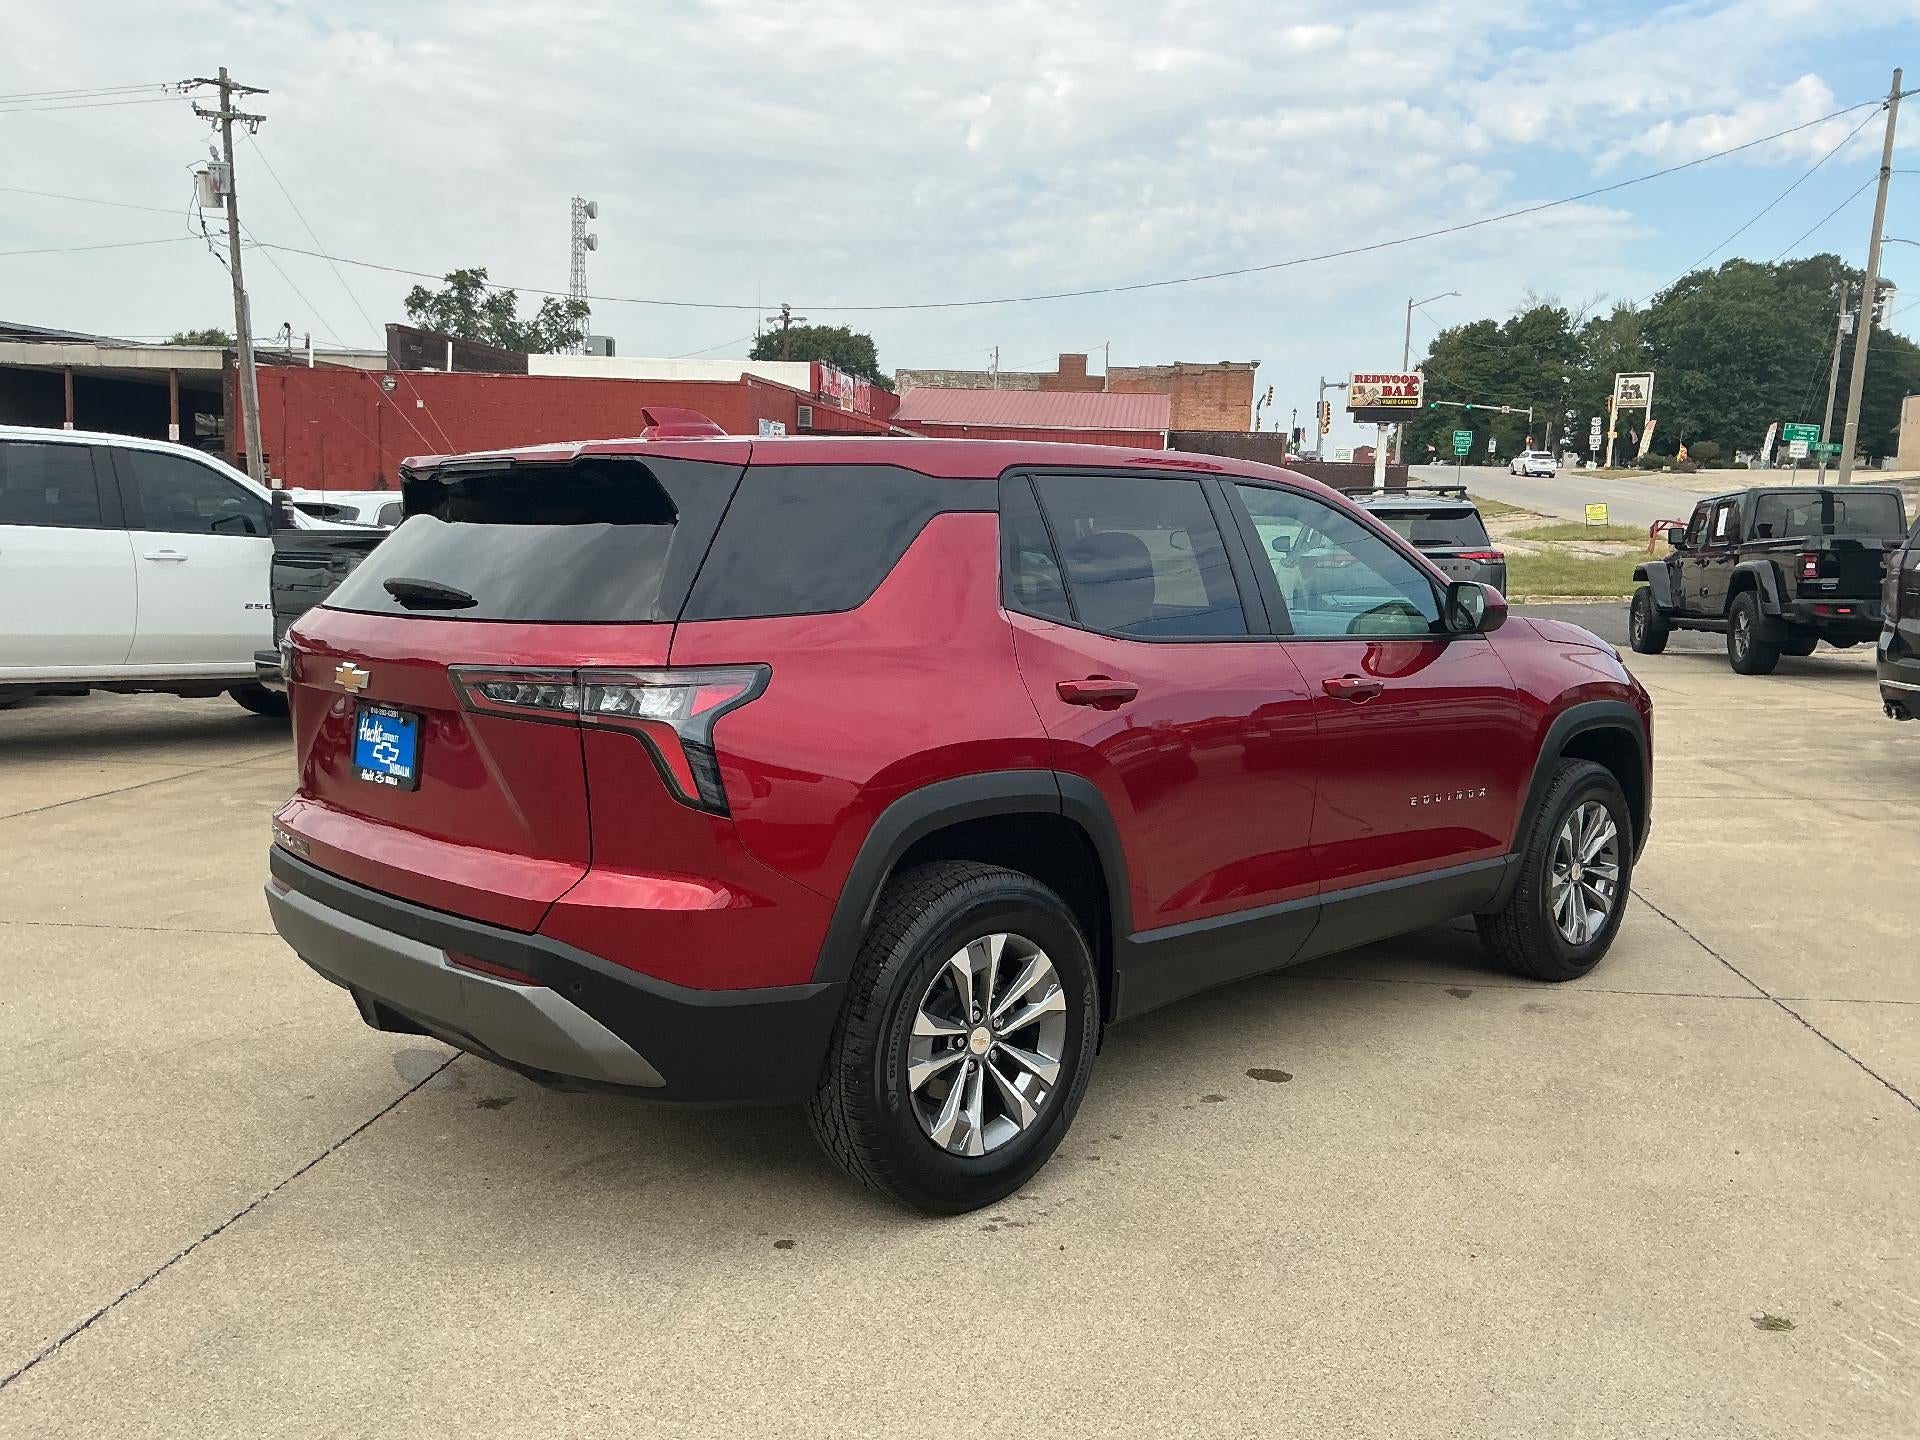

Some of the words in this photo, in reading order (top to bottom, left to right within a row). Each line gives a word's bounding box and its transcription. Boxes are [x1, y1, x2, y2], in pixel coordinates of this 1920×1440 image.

[1353, 374, 1420, 385] REDWOOD
[1381, 385, 1418, 397] BAR
[360, 717, 383, 743] Hecht
[1409, 787, 1486, 806] EQUINOX
[889, 990, 913, 1080] DESTINATION
